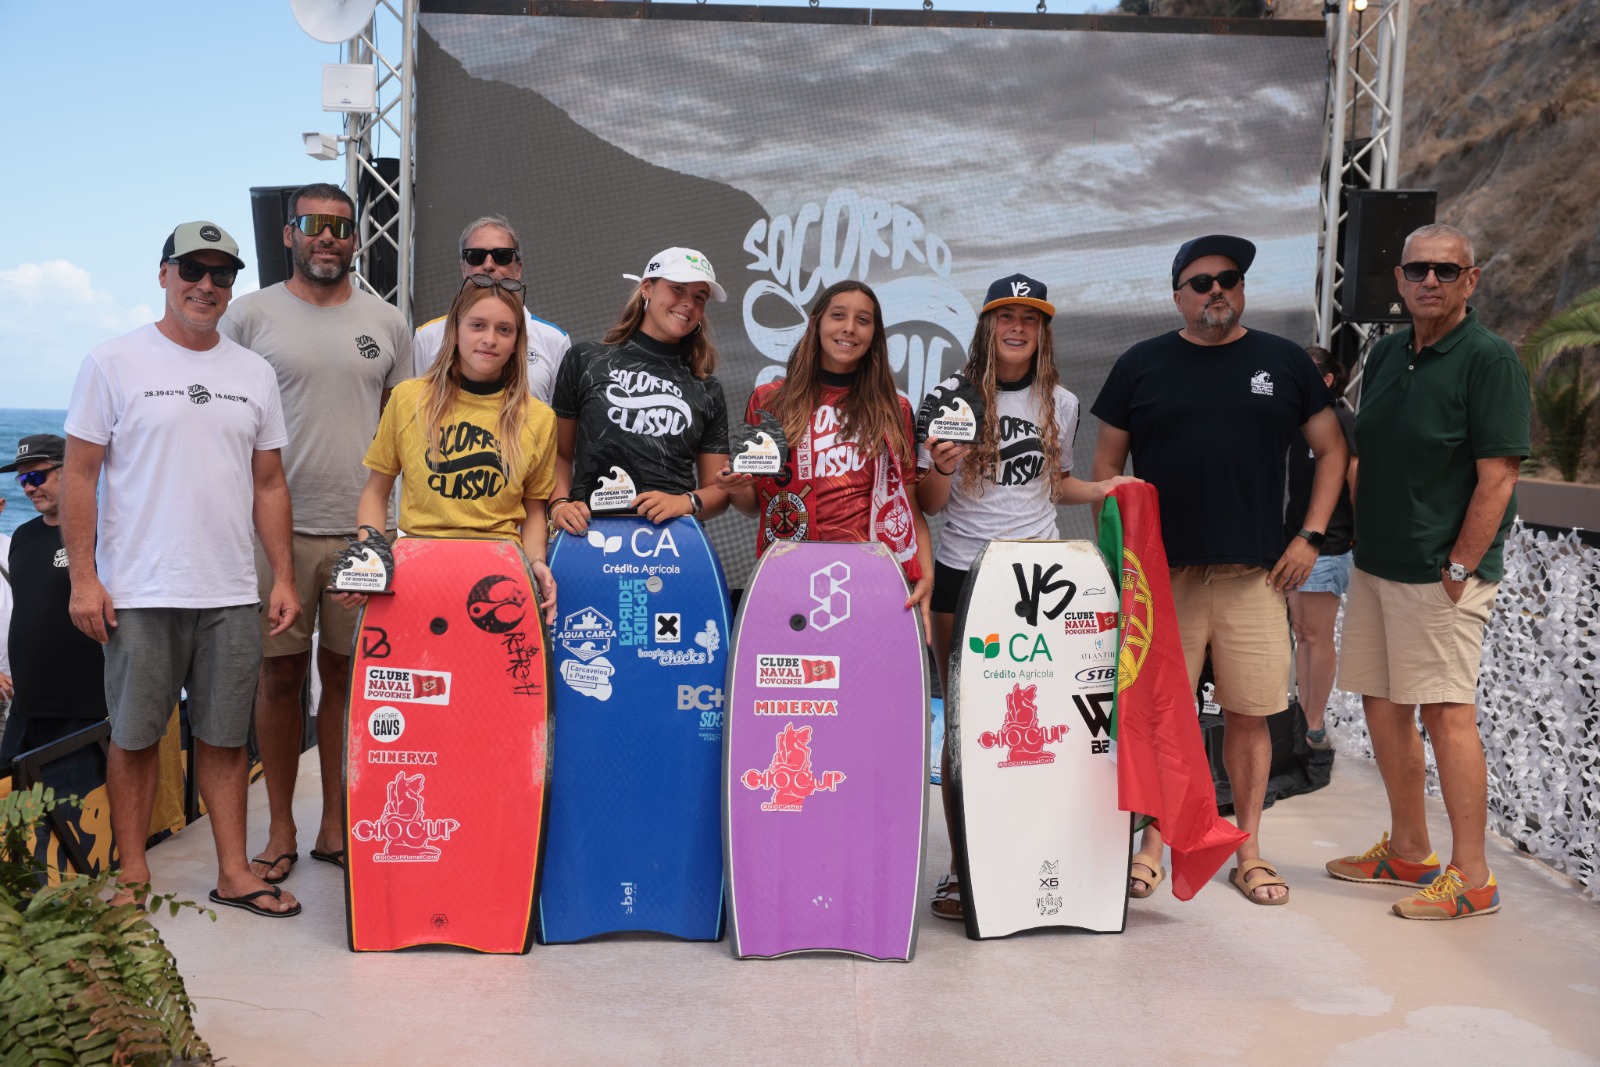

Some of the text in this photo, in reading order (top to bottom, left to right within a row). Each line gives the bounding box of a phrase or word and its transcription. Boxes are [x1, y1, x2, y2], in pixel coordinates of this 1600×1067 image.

[743, 188, 953, 305] SOCORRO
[1011, 281, 1031, 297] VS
[608, 369, 683, 399] SOCORRO
[607, 406, 686, 437] CLASSIC
[815, 445, 869, 478] ASSIC
[427, 469, 502, 500] CLASSIC
[631, 527, 680, 558] CA
[603, 563, 680, 575] Crédito Agrícola
[1012, 562, 1077, 627] VS
[1064, 611, 1095, 620] CLUBE
[1064, 620, 1097, 629] NAVAL
[558, 630, 617, 639] AQUA CARCA
[1008, 633, 1053, 662] CA
[658, 648, 706, 666] chicks
[760, 657, 800, 667] CLUBE
[369, 669, 410, 681] CLUBE
[570, 665, 608, 676] Carcavelos
[574, 672, 599, 682] Parede
[759, 668, 803, 677] NAVAL
[983, 669, 1054, 681] Crédito Agrícola
[368, 680, 412, 692] NAVAL
[367, 690, 412, 700] POVOENSE
[677, 684, 724, 711] BC+
[755, 701, 837, 715] MINERVA
[373, 719, 400, 736] CAVS
[369, 751, 437, 765] MINERVA
[1040, 878, 1059, 887] X6
[1037, 896, 1063, 908] VERSUS
